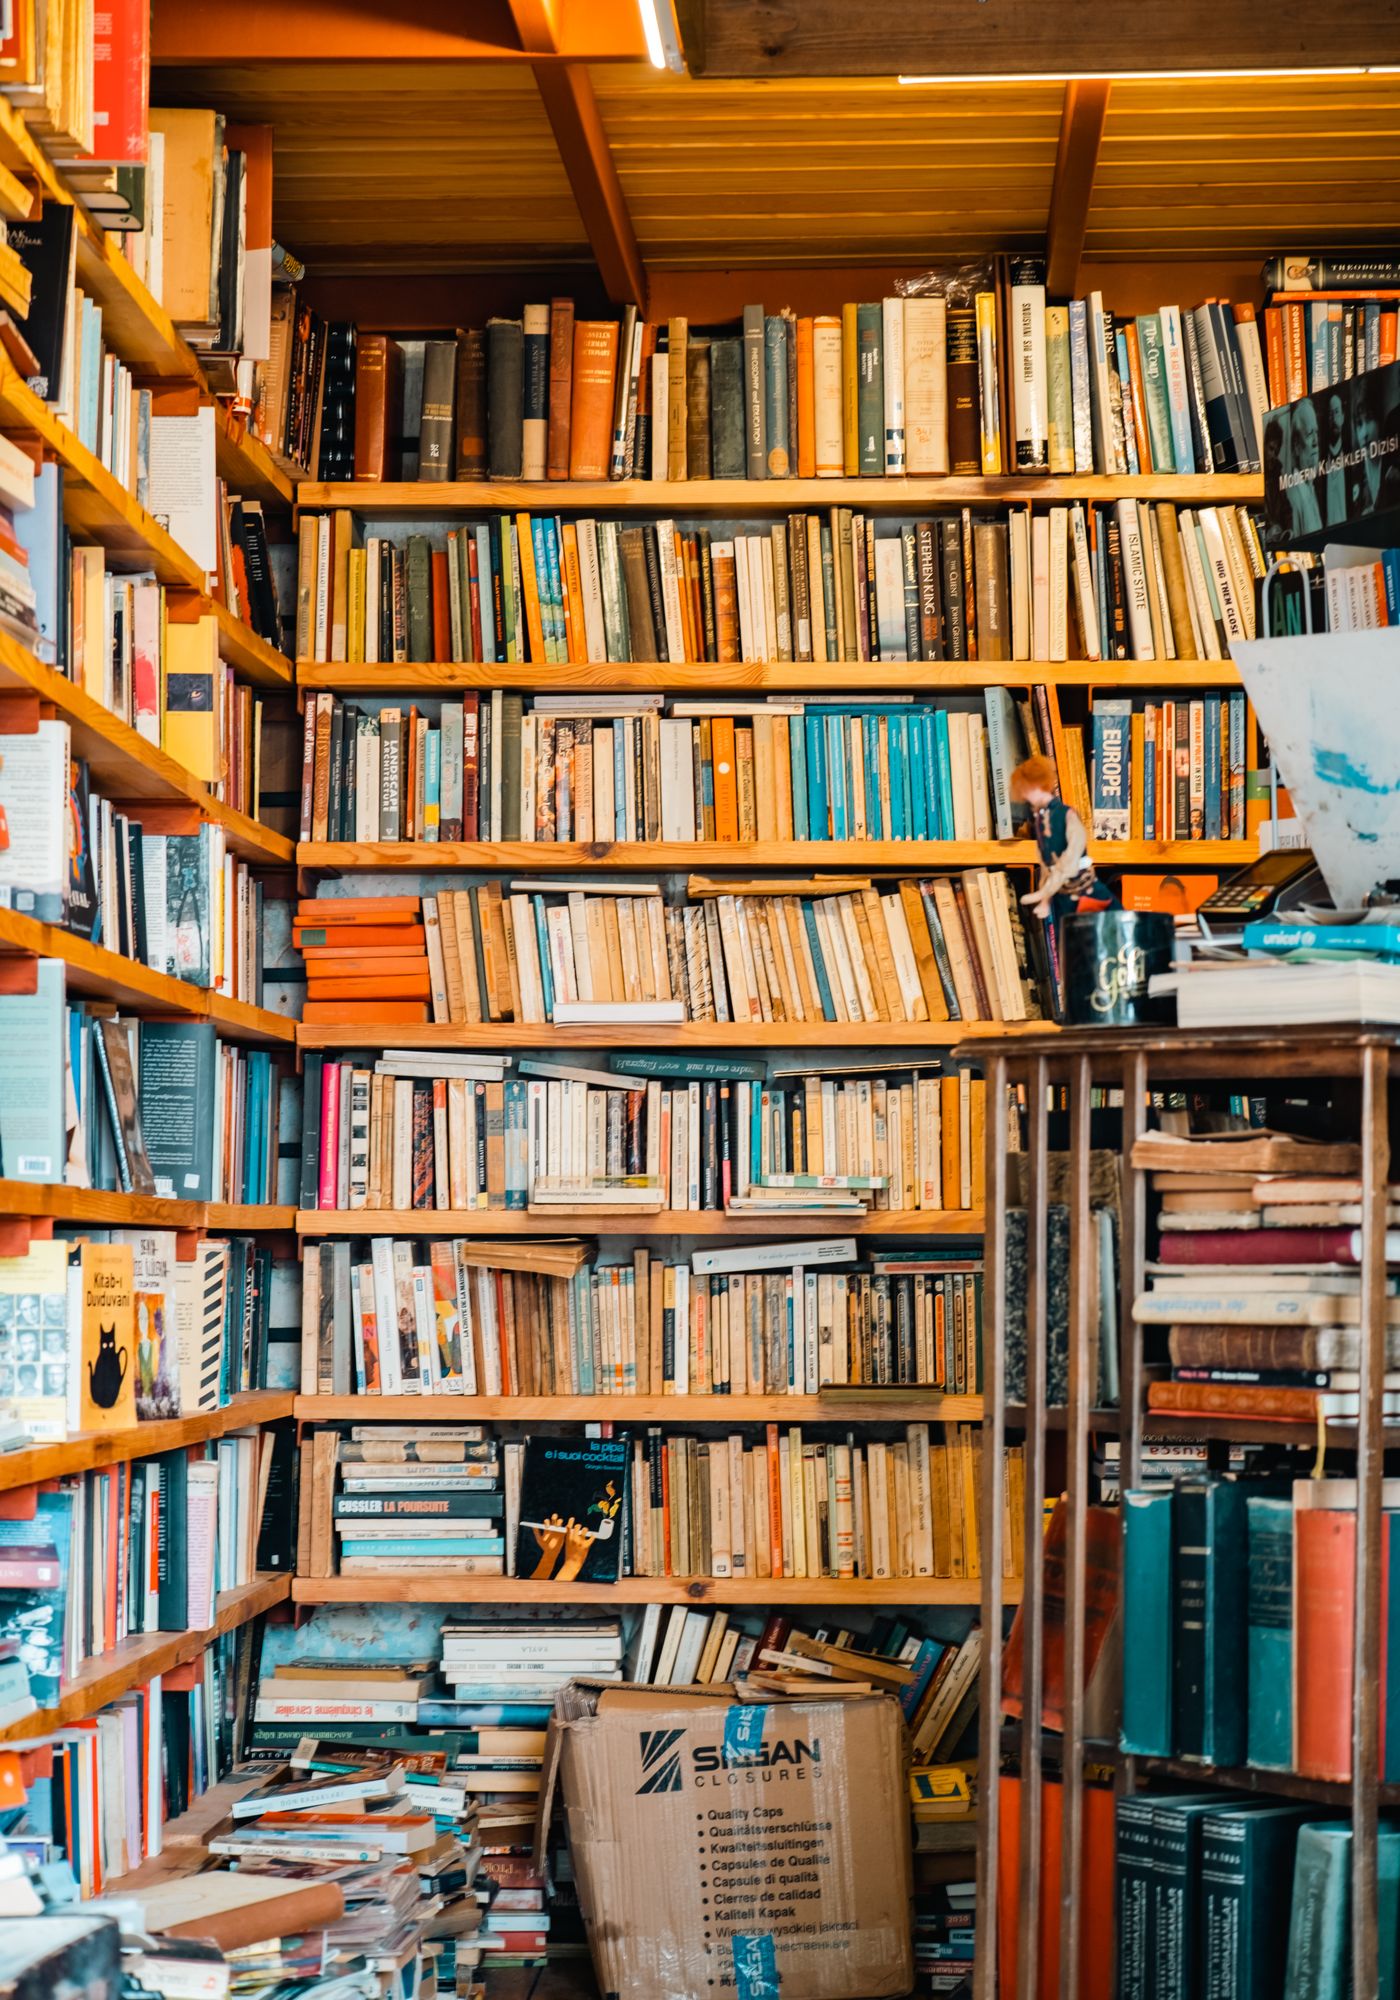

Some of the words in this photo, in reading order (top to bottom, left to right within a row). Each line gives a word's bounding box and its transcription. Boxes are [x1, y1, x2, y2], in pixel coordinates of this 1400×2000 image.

[1331, 263, 1392, 271] THEODORE
[1021, 302, 1032, 338] INVASIONS
[1073, 319, 1087, 334] My
[1291, 306, 1302, 348] COUNTDOWN
[1102, 314, 1115, 354] PARIS
[1145, 327, 1158, 347] The
[1021, 339, 1033, 353] DES
[1073, 335, 1087, 357] Way
[1293, 349, 1302, 359] TO
[750, 347, 760, 389] PHILOSOPHY
[1021, 354, 1034, 384] L'EUROPE
[1146, 348, 1161, 379] Coup
[751, 390, 760, 404] and
[751, 405, 761, 445] EDUCATION
[1279, 470, 1317, 492] MODERN
[535, 528, 543, 550] Village
[547, 529, 555, 551] Village
[775, 533, 785, 564] ANNIE
[1108, 529, 1122, 556] IRAQ
[920, 530, 936, 583] STEPHEN
[1126, 533, 1144, 577] ISLAMIC
[1135, 579, 1147, 611] STATE
[1215, 560, 1226, 580] HUG
[778, 566, 787, 608] PROULX
[949, 571, 958, 598] CLIENT
[1219, 581, 1232, 606] THEM
[923, 583, 936, 616] KING
[951, 606, 960, 626] JOHN
[1226, 607, 1241, 638] CLOSE
[952, 625, 961, 660] GRISHAM
[1193, 708, 1203, 731] POWER
[304, 730, 315, 743] of
[1194, 732, 1203, 745] AND
[303, 743, 314, 765] love
[1101, 729, 1123, 798] EUROPE
[1194, 746, 1204, 767] POLICY
[382, 739, 391, 814] ARCHITECTURE
[390, 739, 401, 814] LANDSCAPE
[1194, 775, 1204, 794] SYRIA
[1262, 930, 1302, 946] unicef
[686, 1063, 706, 1074] nuit
[705, 1064, 716, 1074] la
[715, 1065, 731, 1073] est
[94, 1272, 123, 1289] Kitab-ı
[457, 1268, 467, 1292] MAISON
[86, 1290, 131, 1308] Duvduvani
[558, 1450, 582, 1461] suoi
[581, 1450, 625, 1463] cocktail
[590, 1441, 602, 1451] la
[602, 1442, 625, 1454] pipa
[1149, 1445, 1207, 1458] Rusça
[337, 1500, 383, 1514] CUSSLER
[383, 1500, 396, 1514] LA
[397, 1499, 450, 1514] POURSUITE
[274, 1705, 312, 1718] cavalier
[314, 1703, 363, 1719] cinquième
[694, 1767, 824, 1788] CLOSURES
[707, 1809, 750, 1823] Quality
[752, 1806, 785, 1821] Caps
[709, 1821, 833, 1838] Qualitätsverschlüsse
[712, 1858, 765, 1873] Capsules
[770, 1857, 785, 1869] de
[788, 1851, 831, 1868] Qualité
[713, 1875, 761, 1890] Capsule
[764, 1874, 775, 1885] di
[778, 1871, 821, 1887] qualità
[714, 1892, 757, 1906] Cierres
[759, 1891, 775, 1903] de
[778, 1888, 822, 1902] calidad
[715, 1909, 756, 1922] Kaliteli
[758, 1906, 797, 1921] Kapak
[1302, 1888, 1320, 1954] Literature
[716, 1926, 765, 1939] Wieczka
[767, 1921, 818, 1937] wysokiej
[1132, 1880, 1142, 1978] SADRIAZAMLAR
[1166, 1888, 1178, 1987] SADRIAZAMLAR
[1220, 1897, 1232, 1998] SADRIAZAMLAR
[1299, 1974, 1311, 1997] the
